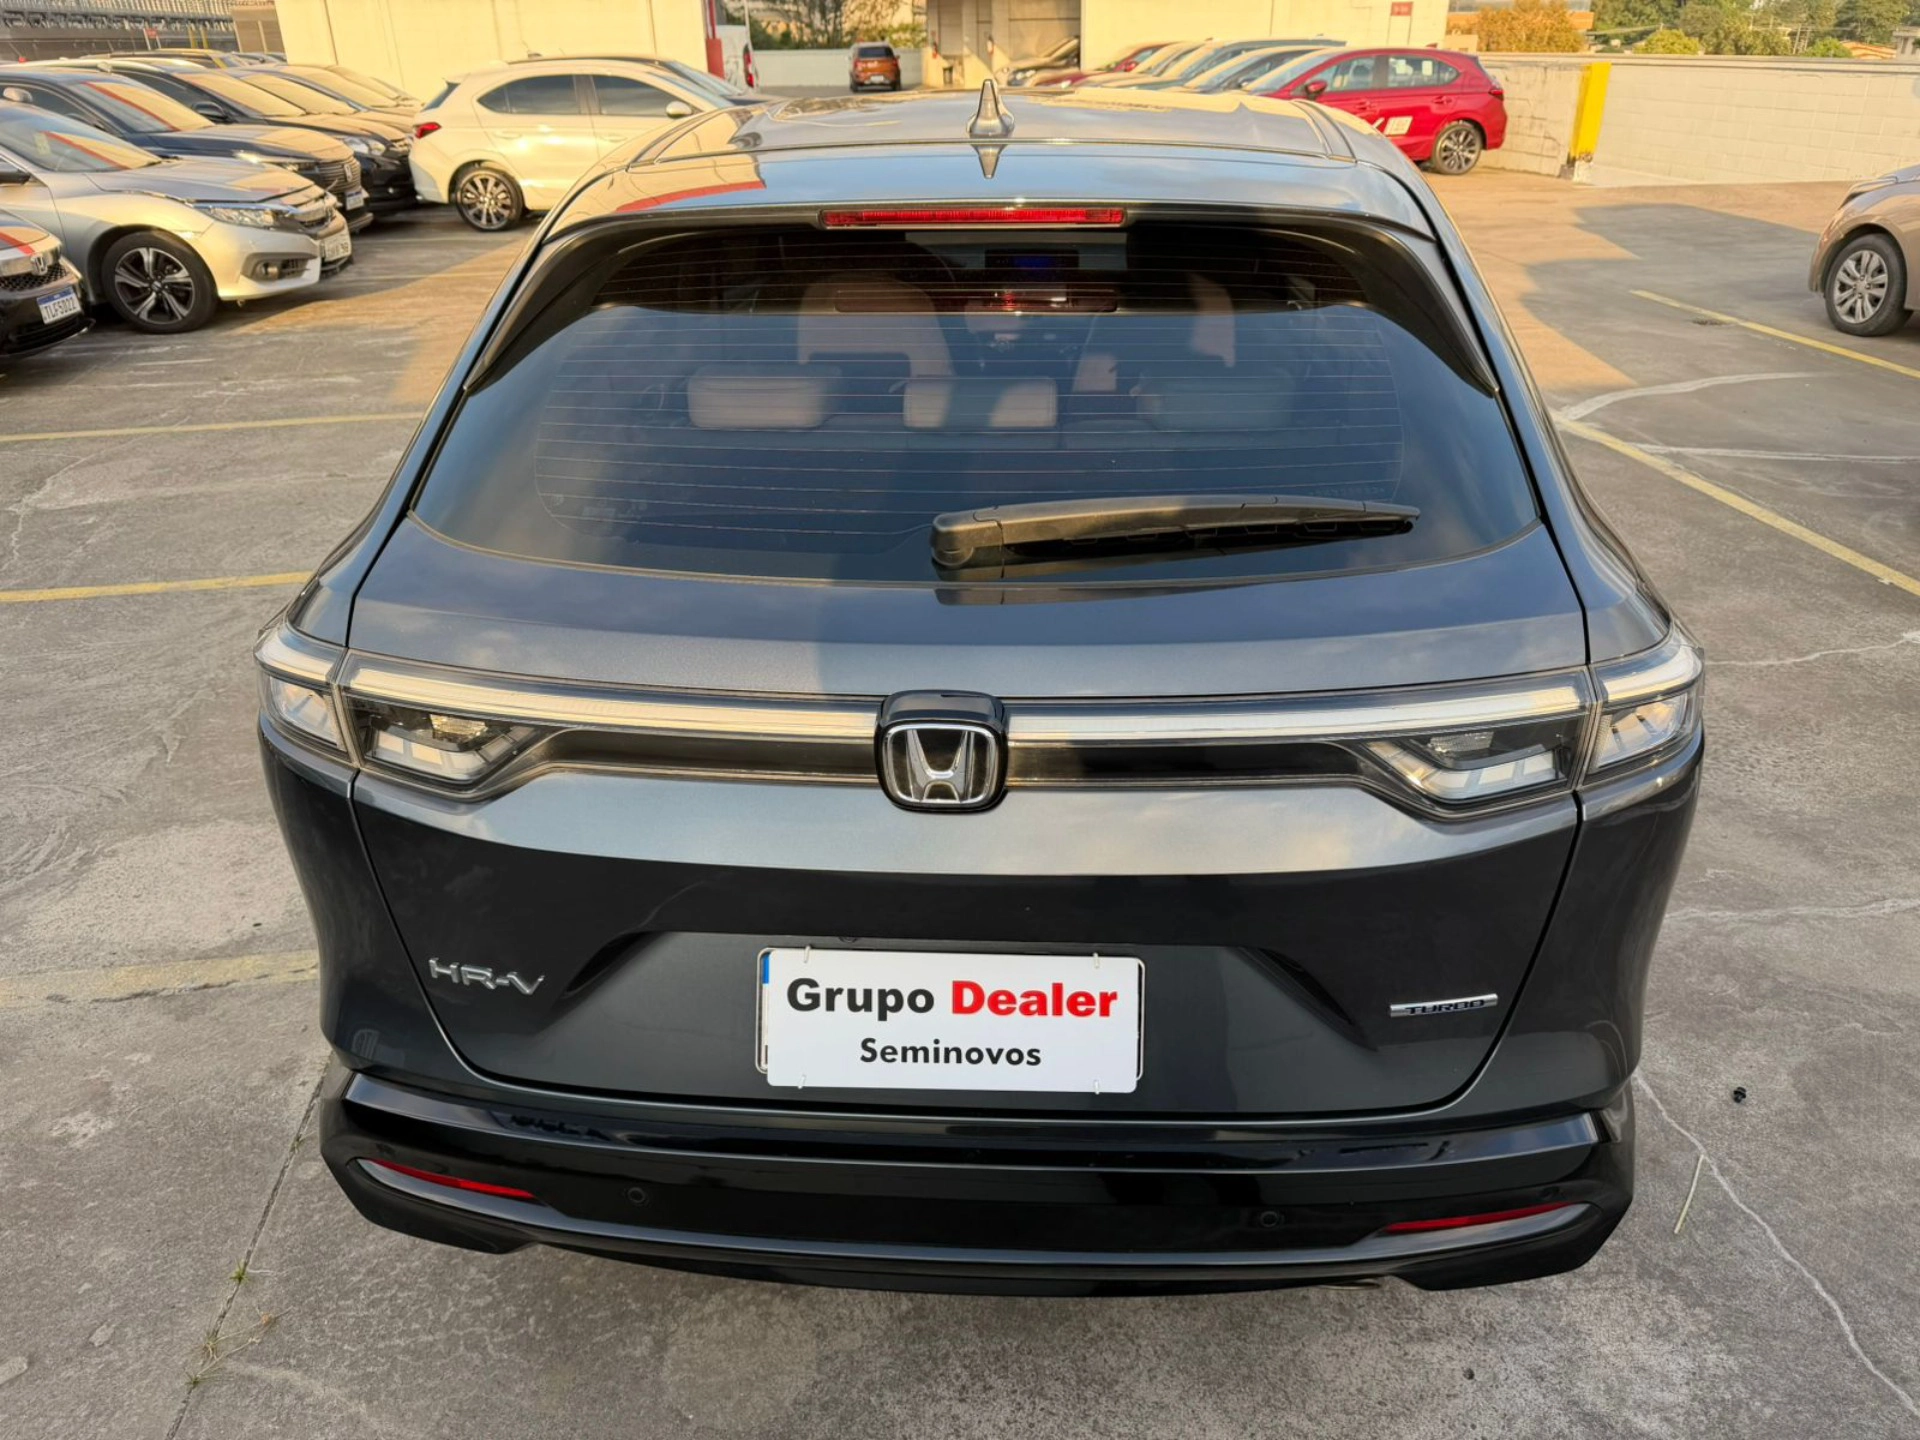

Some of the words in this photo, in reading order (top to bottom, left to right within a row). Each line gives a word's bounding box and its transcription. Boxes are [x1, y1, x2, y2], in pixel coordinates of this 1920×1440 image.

[429, 957, 545, 995] HR-V
[786, 977, 935, 1021] Grupo
[951, 980, 1118, 1017] Dealer
[1404, 999, 1485, 1015] TURBO
[860, 1037, 1042, 1066] Seminovos
